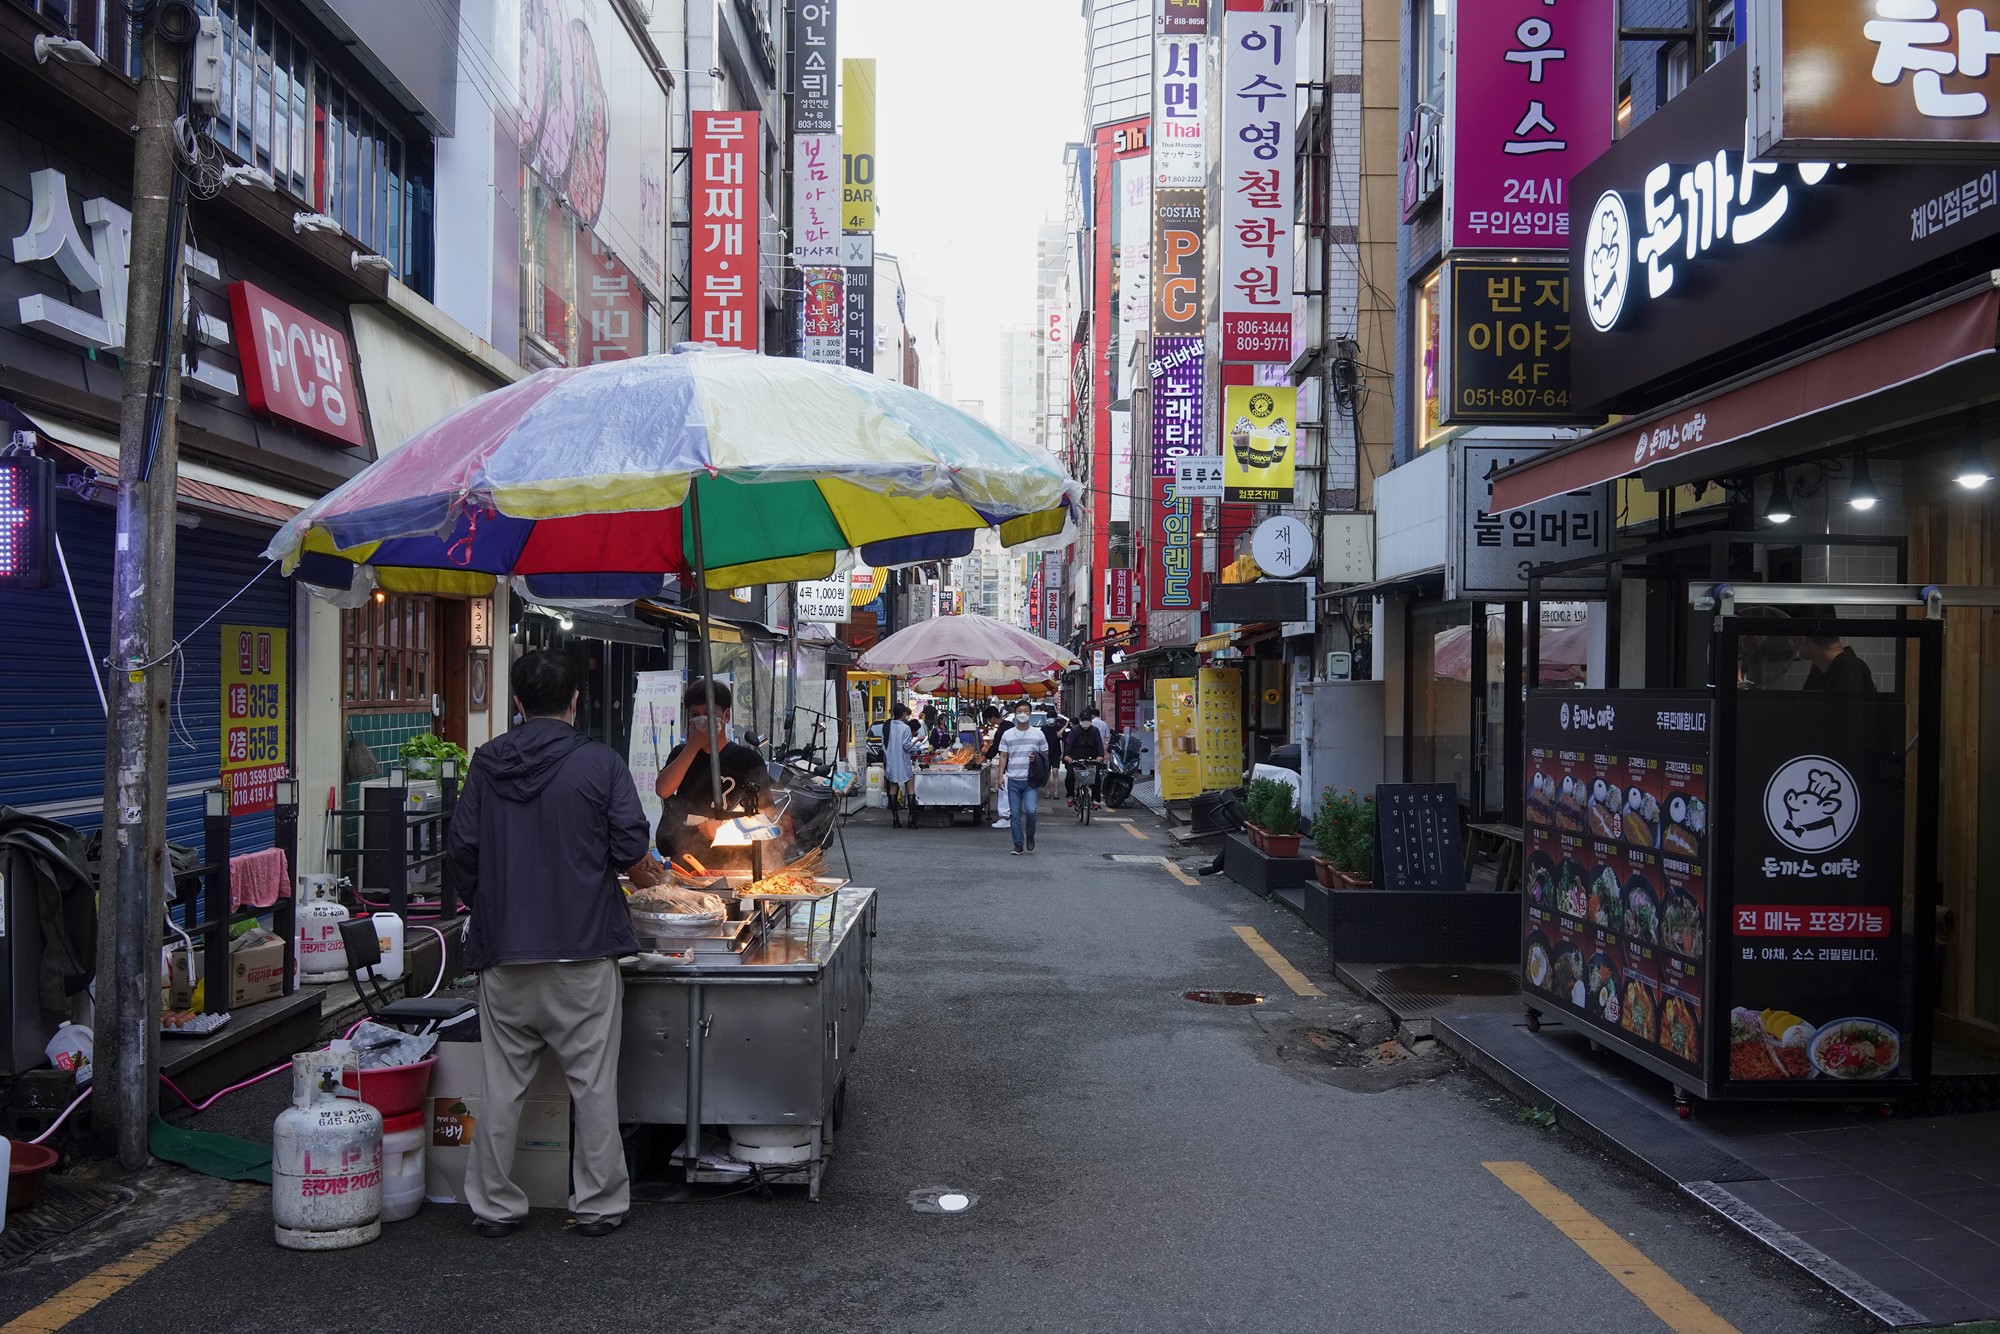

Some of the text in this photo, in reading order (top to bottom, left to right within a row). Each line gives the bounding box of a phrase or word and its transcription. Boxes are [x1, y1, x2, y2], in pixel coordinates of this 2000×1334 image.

[802, 0, 831, 96] 아노소리
[1864, 0, 2000, 117] 찬
[1163, 42, 1198, 118] 서면
[1504, 0, 1566, 155] 우스
[798, 119, 832, 129] 803-1399
[1163, 122, 1200, 138] Thai
[1161, 151, 1201, 159] マッサージ
[1234, 24, 1286, 305] 이수영철학원
[843, 153, 875, 185] 10
[843, 189, 873, 203] BAR
[1909, 169, 1998, 243] 체인점문의
[849, 215, 866, 227] 4F
[1160, 206, 1201, 218] COSTAR
[704, 117, 745, 350] 부대찌개·부대
[795, 246, 838, 257] 마사지
[847, 273, 867, 286] CHOI
[1163, 230, 1200, 322] PC
[1487, 275, 1569, 313] 반지
[810, 303, 840, 318] 노래
[806, 319, 843, 334] 연습장
[1050, 314, 1061, 342] PC
[1237, 320, 1290, 335] 806-3444
[1237, 337, 1290, 351] 809-9771
[260, 306, 348, 427] PC방
[1149, 338, 1205, 379] 알리바바
[1507, 363, 1550, 385] 4F
[1250, 394, 1273, 405] COMPOSE
[1252, 408, 1271, 418] COFFEE
[1649, 413, 1707, 458] 돈까스 예찬
[1239, 489, 1279, 500] 컴포즈커피
[1473, 510, 1600, 547] 붙임머리
[1162, 484, 1192, 606] 게임랜드
[799, 587, 845, 600] 4곡 1,000원
[1117, 569, 1127, 615] 천씨씨커피
[799, 604, 845, 617] 1시간 5,000원
[1048, 592, 1059, 631] 청춘스타
[475, 601, 483, 644] そうそう
[231, 684, 279, 719] 1층 35평
[1572, 704, 1706, 732] 돈까스 예찬 주류판매합니다
[230, 725, 279, 761] 2층 55평
[233, 766, 286, 789] 010.3599.0343
[1761, 857, 1861, 879] 돈까스 예찬
[1738, 911, 1883, 932] 전 메뉴 포장가능
[1742, 948, 1879, 961] 밥, 야채, 소스 리필됩니다.
[246, 967, 273, 984] 튀김가루
[318, 1113, 373, 1127] 645-4200
[301, 1177, 349, 1197] 충전기한
